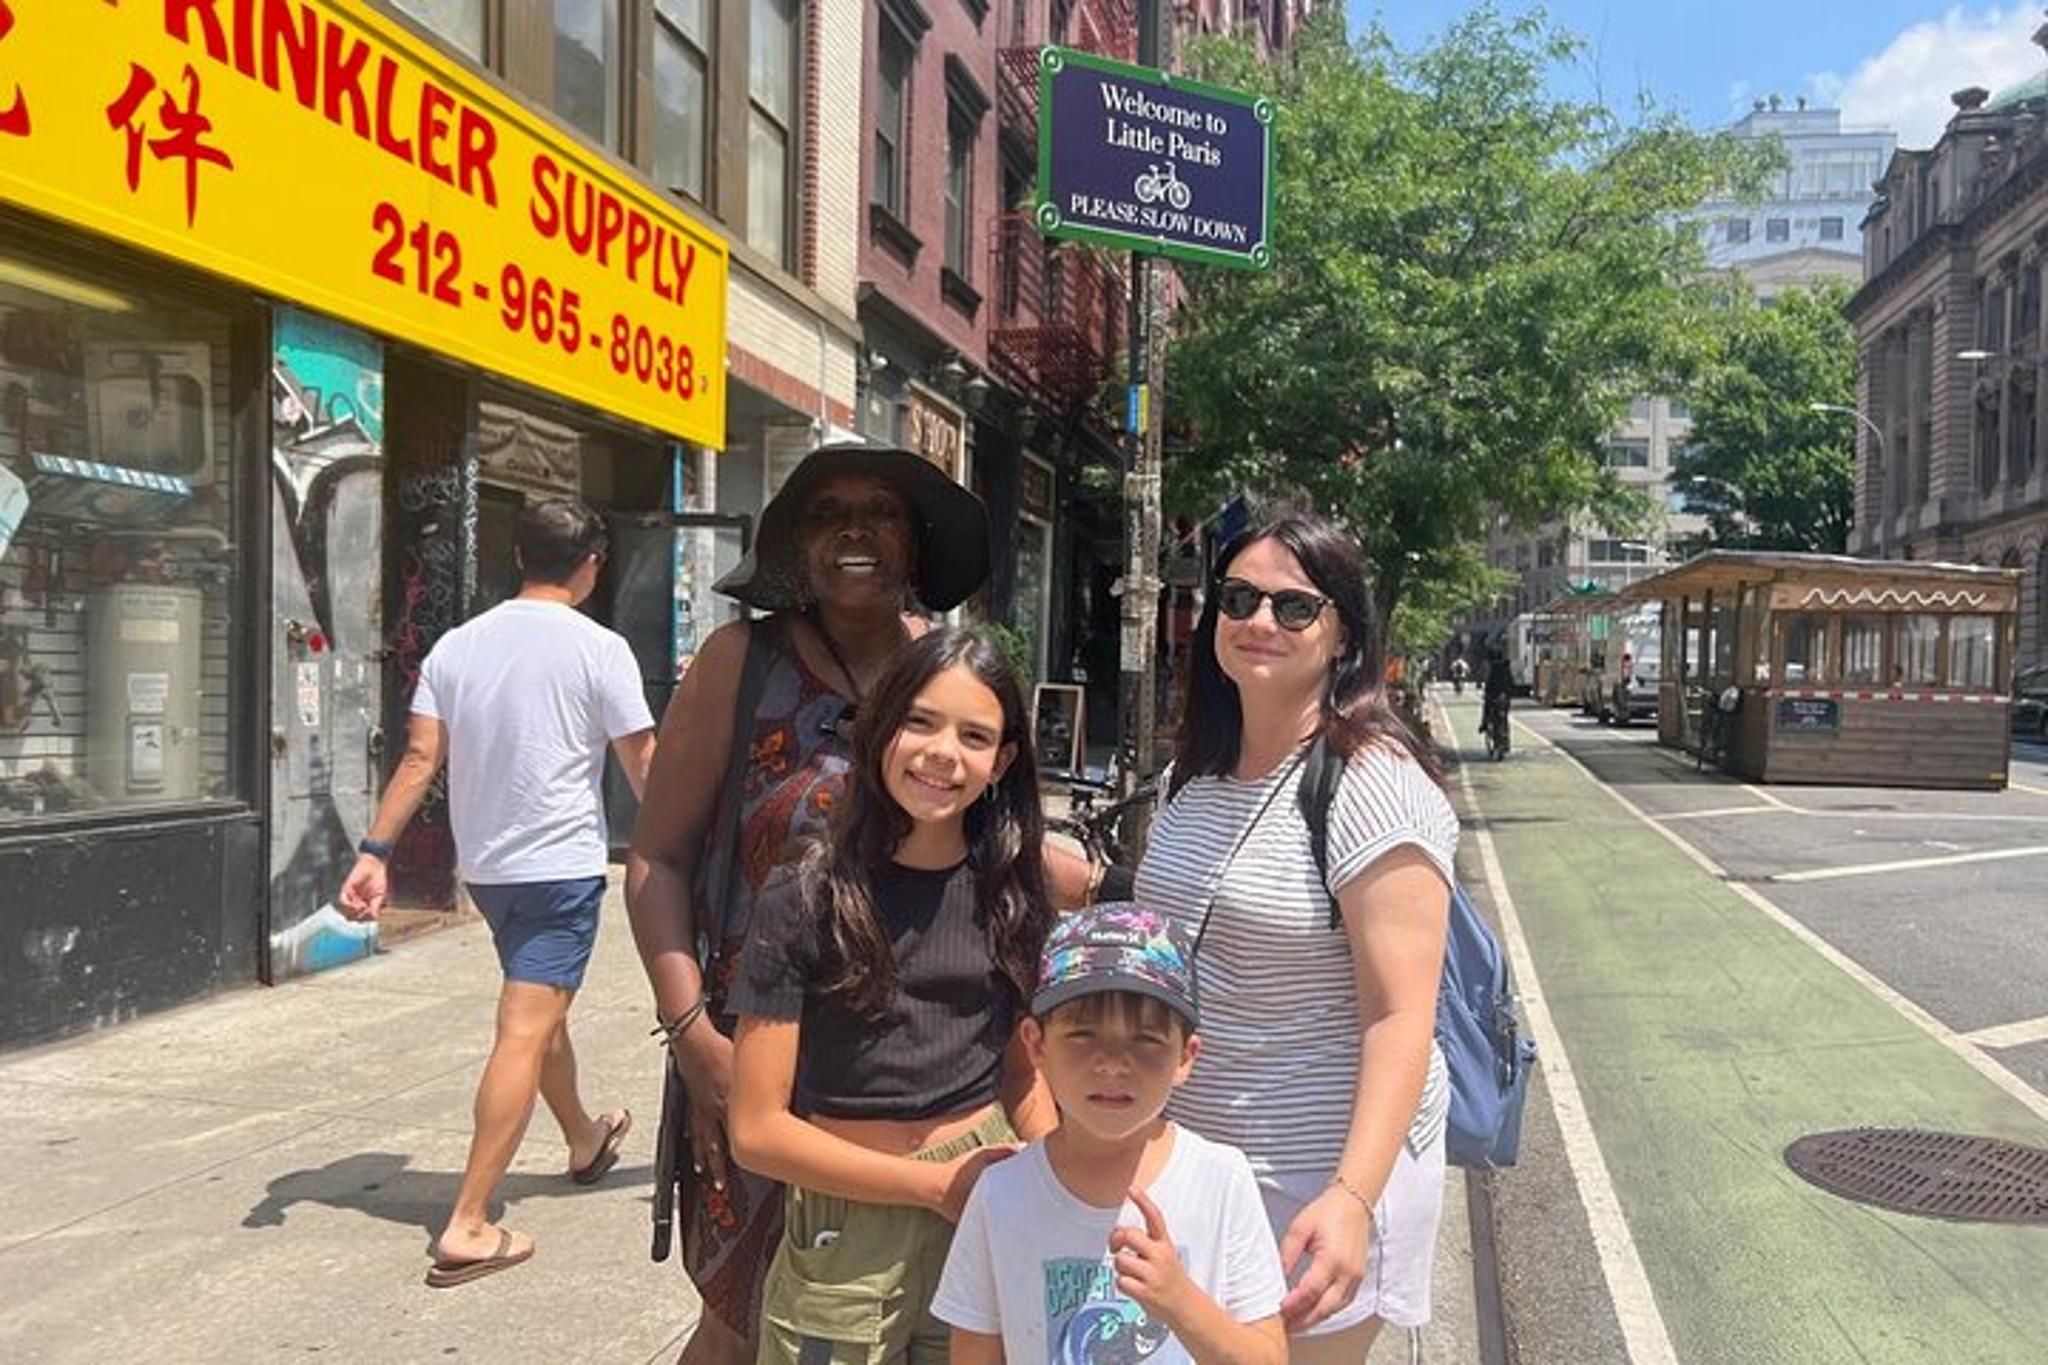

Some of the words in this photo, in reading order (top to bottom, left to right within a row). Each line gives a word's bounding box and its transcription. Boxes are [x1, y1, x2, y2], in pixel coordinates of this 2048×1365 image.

[1100, 82, 1202, 129] Welcome
[1206, 112, 1227, 135] to
[1107, 118, 1164, 154] Little
[1168, 132, 1222, 168] Paris
[530, 154, 695, 307] SUPPLY
[1071, 193, 1138, 224] PLEASE
[1140, 207, 1193, 233] SLOW
[1193, 214, 1248, 243] DOWN
